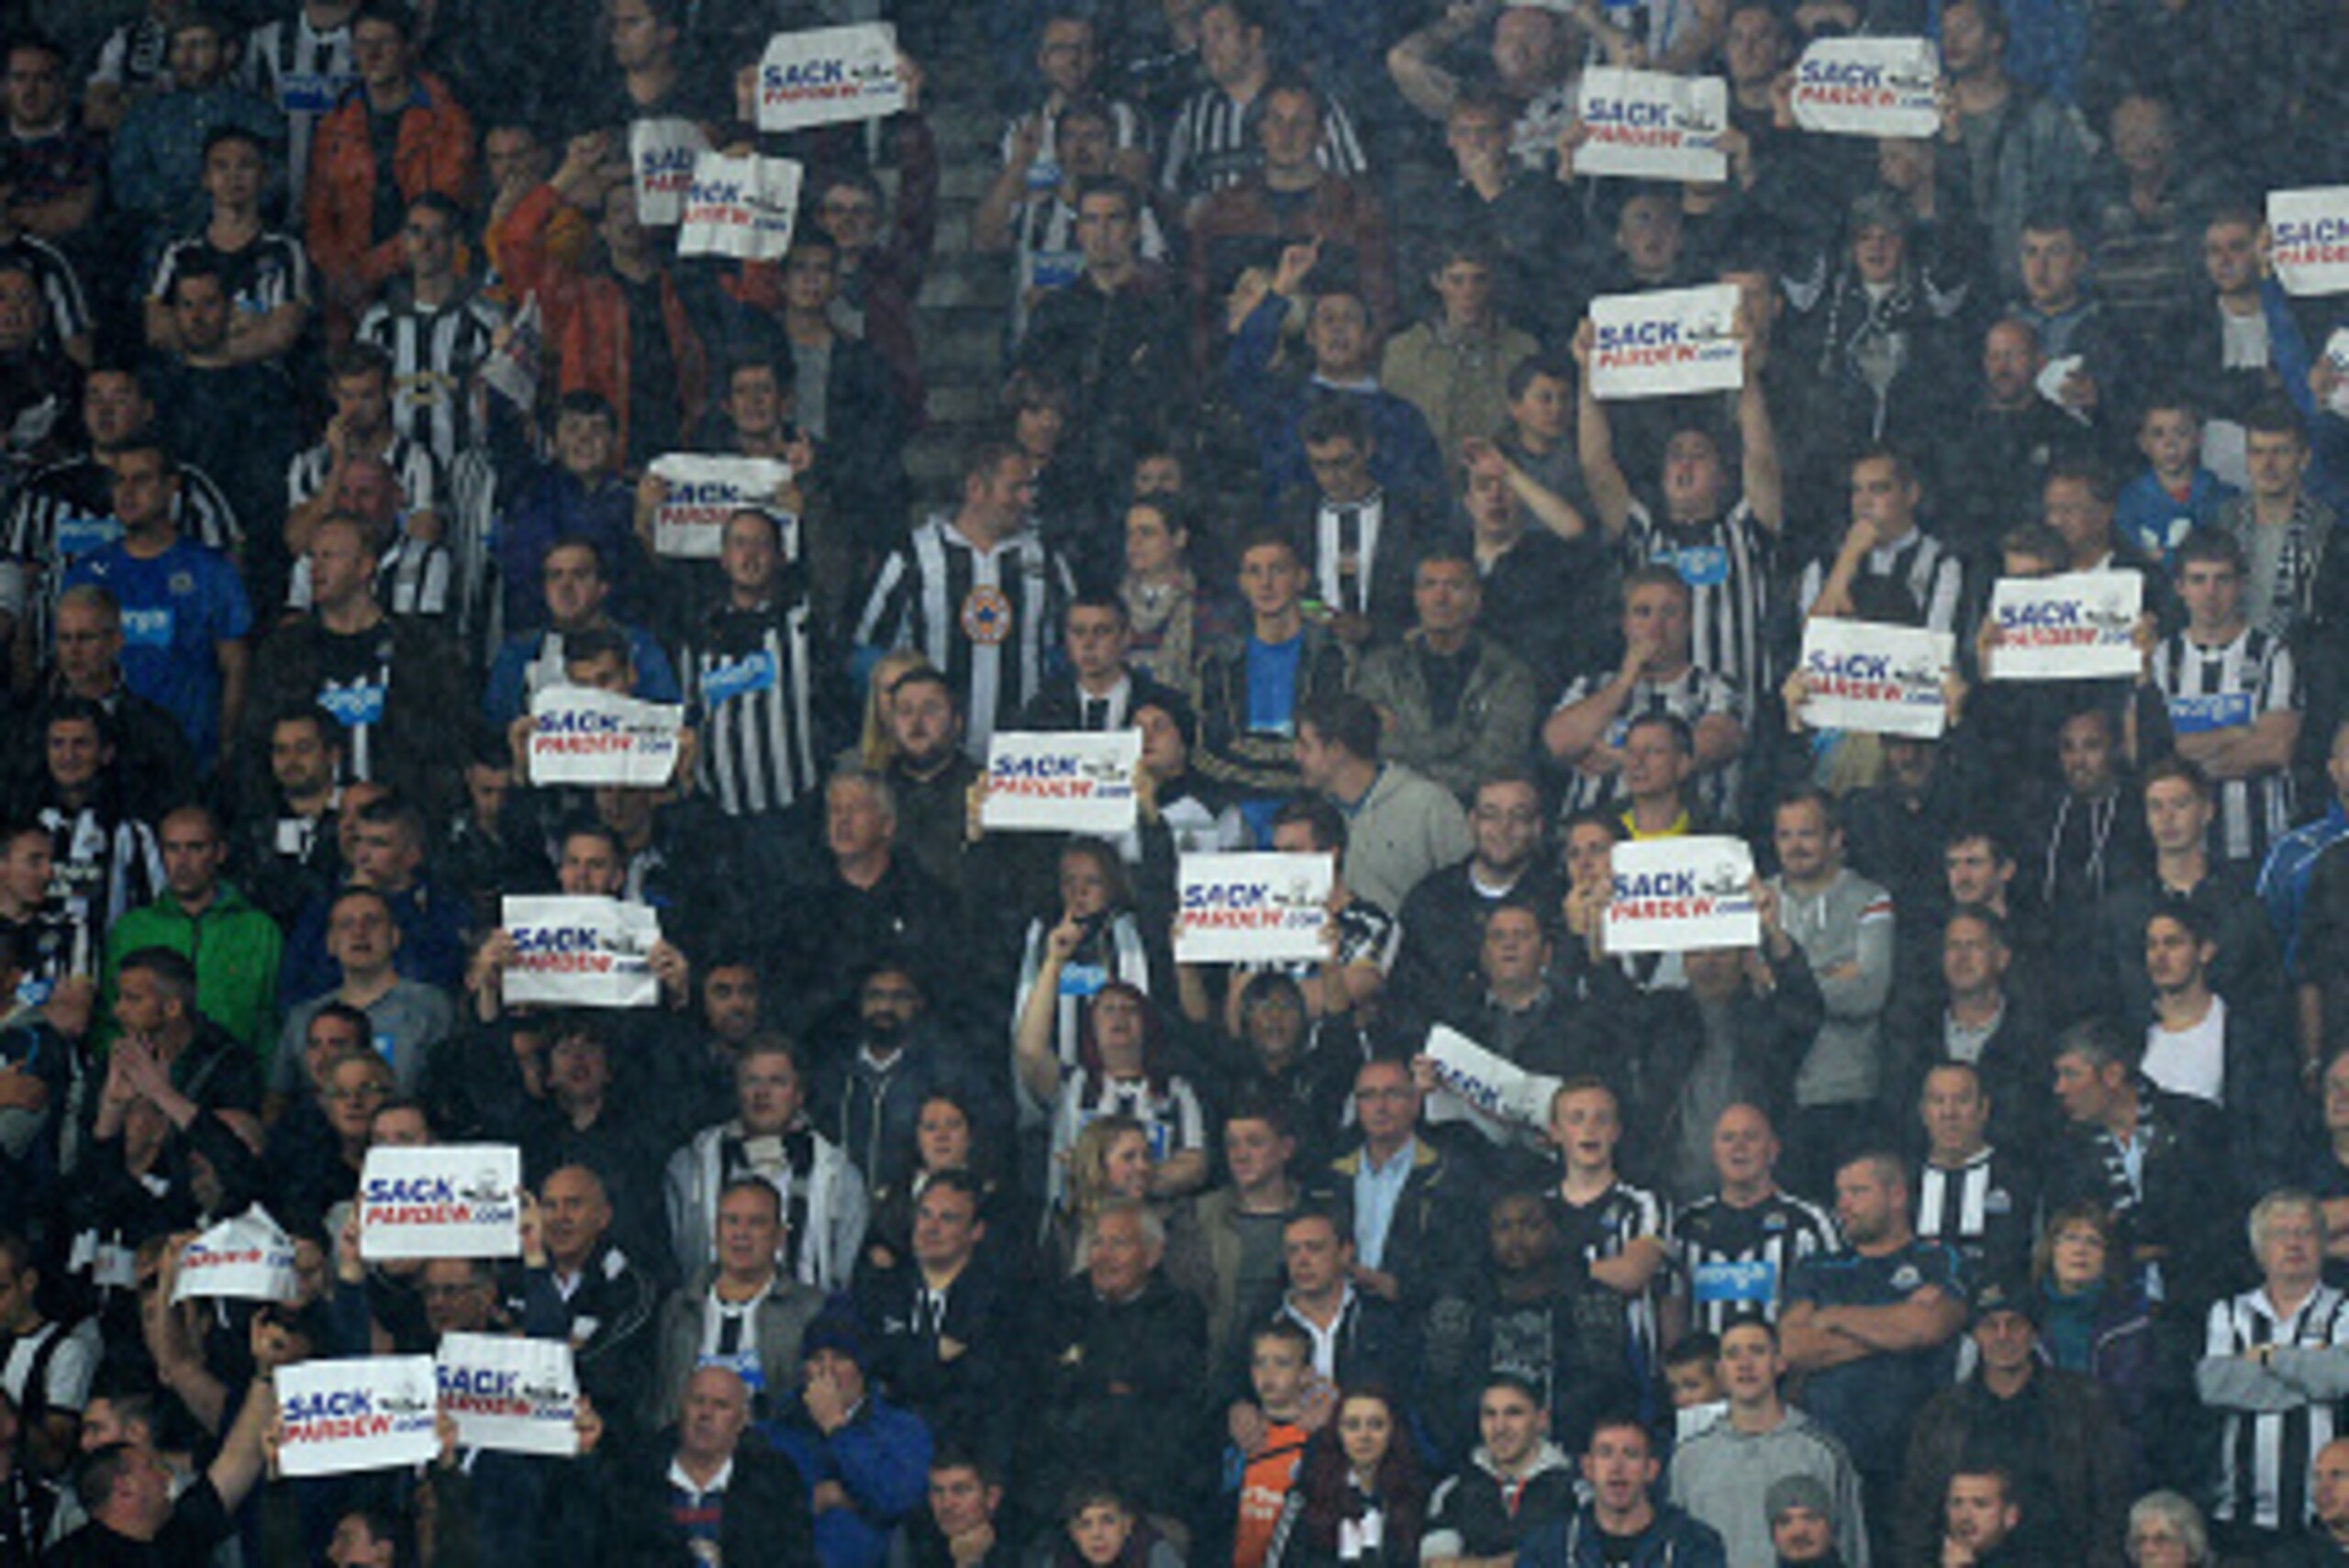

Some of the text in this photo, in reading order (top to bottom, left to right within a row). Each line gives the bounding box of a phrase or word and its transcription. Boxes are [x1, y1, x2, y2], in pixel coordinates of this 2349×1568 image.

[763, 60, 843, 88] SACK
[1801, 60, 1884, 87] SACK
[1586, 98, 1671, 127] SACK
[1598, 320, 1680, 351] SACK
[2000, 599, 2082, 628] SACK
[1807, 649, 1891, 679] SACK
[537, 709, 623, 733] SACK
[993, 753, 1079, 777] SACK
[1184, 884, 1270, 908] SACK
[1611, 869, 1696, 899] SACK
[512, 926, 598, 952] SACK
[366, 1176, 455, 1204] SACK
[436, 1365, 520, 1397] SACK
[283, 1389, 373, 1421] SACK
